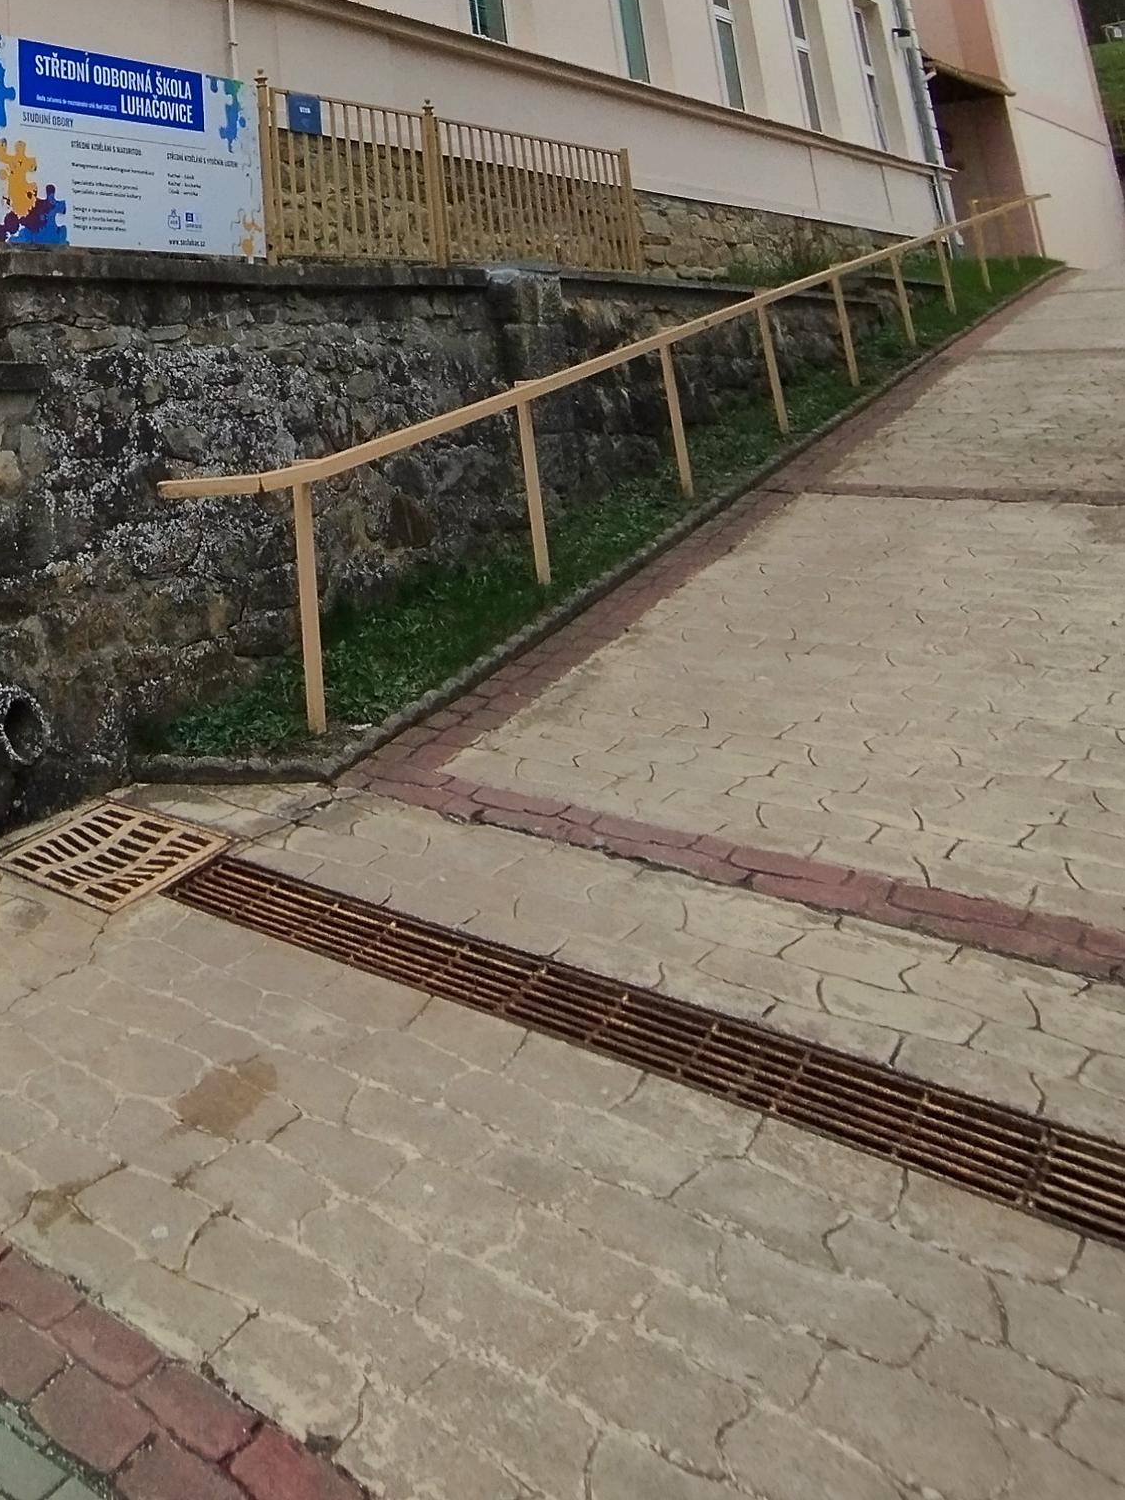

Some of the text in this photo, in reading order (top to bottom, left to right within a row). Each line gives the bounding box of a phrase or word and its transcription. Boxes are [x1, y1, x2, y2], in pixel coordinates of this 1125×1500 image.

[35, 52, 192, 100] STŘEDNÍ ODBORNÁ ŠKOLA
[121, 94, 193, 124] LUHAČOVICE
